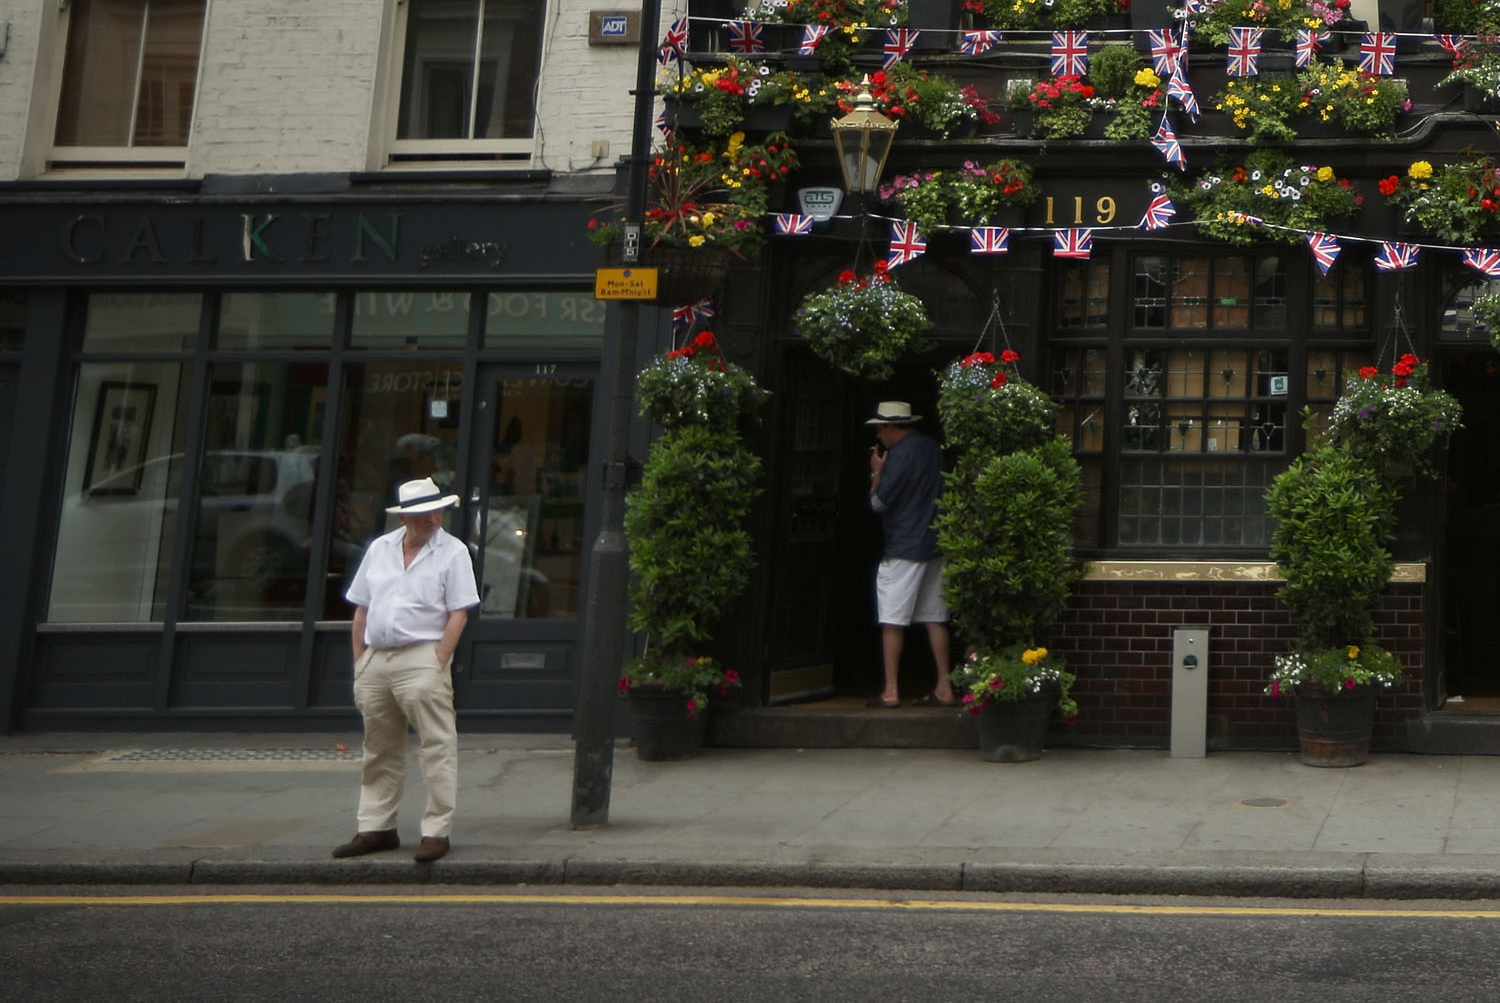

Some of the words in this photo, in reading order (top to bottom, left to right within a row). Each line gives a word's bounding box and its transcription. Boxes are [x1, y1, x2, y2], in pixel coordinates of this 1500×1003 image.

[603, 20, 626, 33] ADT
[1045, 196, 1116, 224] 119
[61, 213, 406, 265] CALKEN
[536, 363, 557, 375] 117
